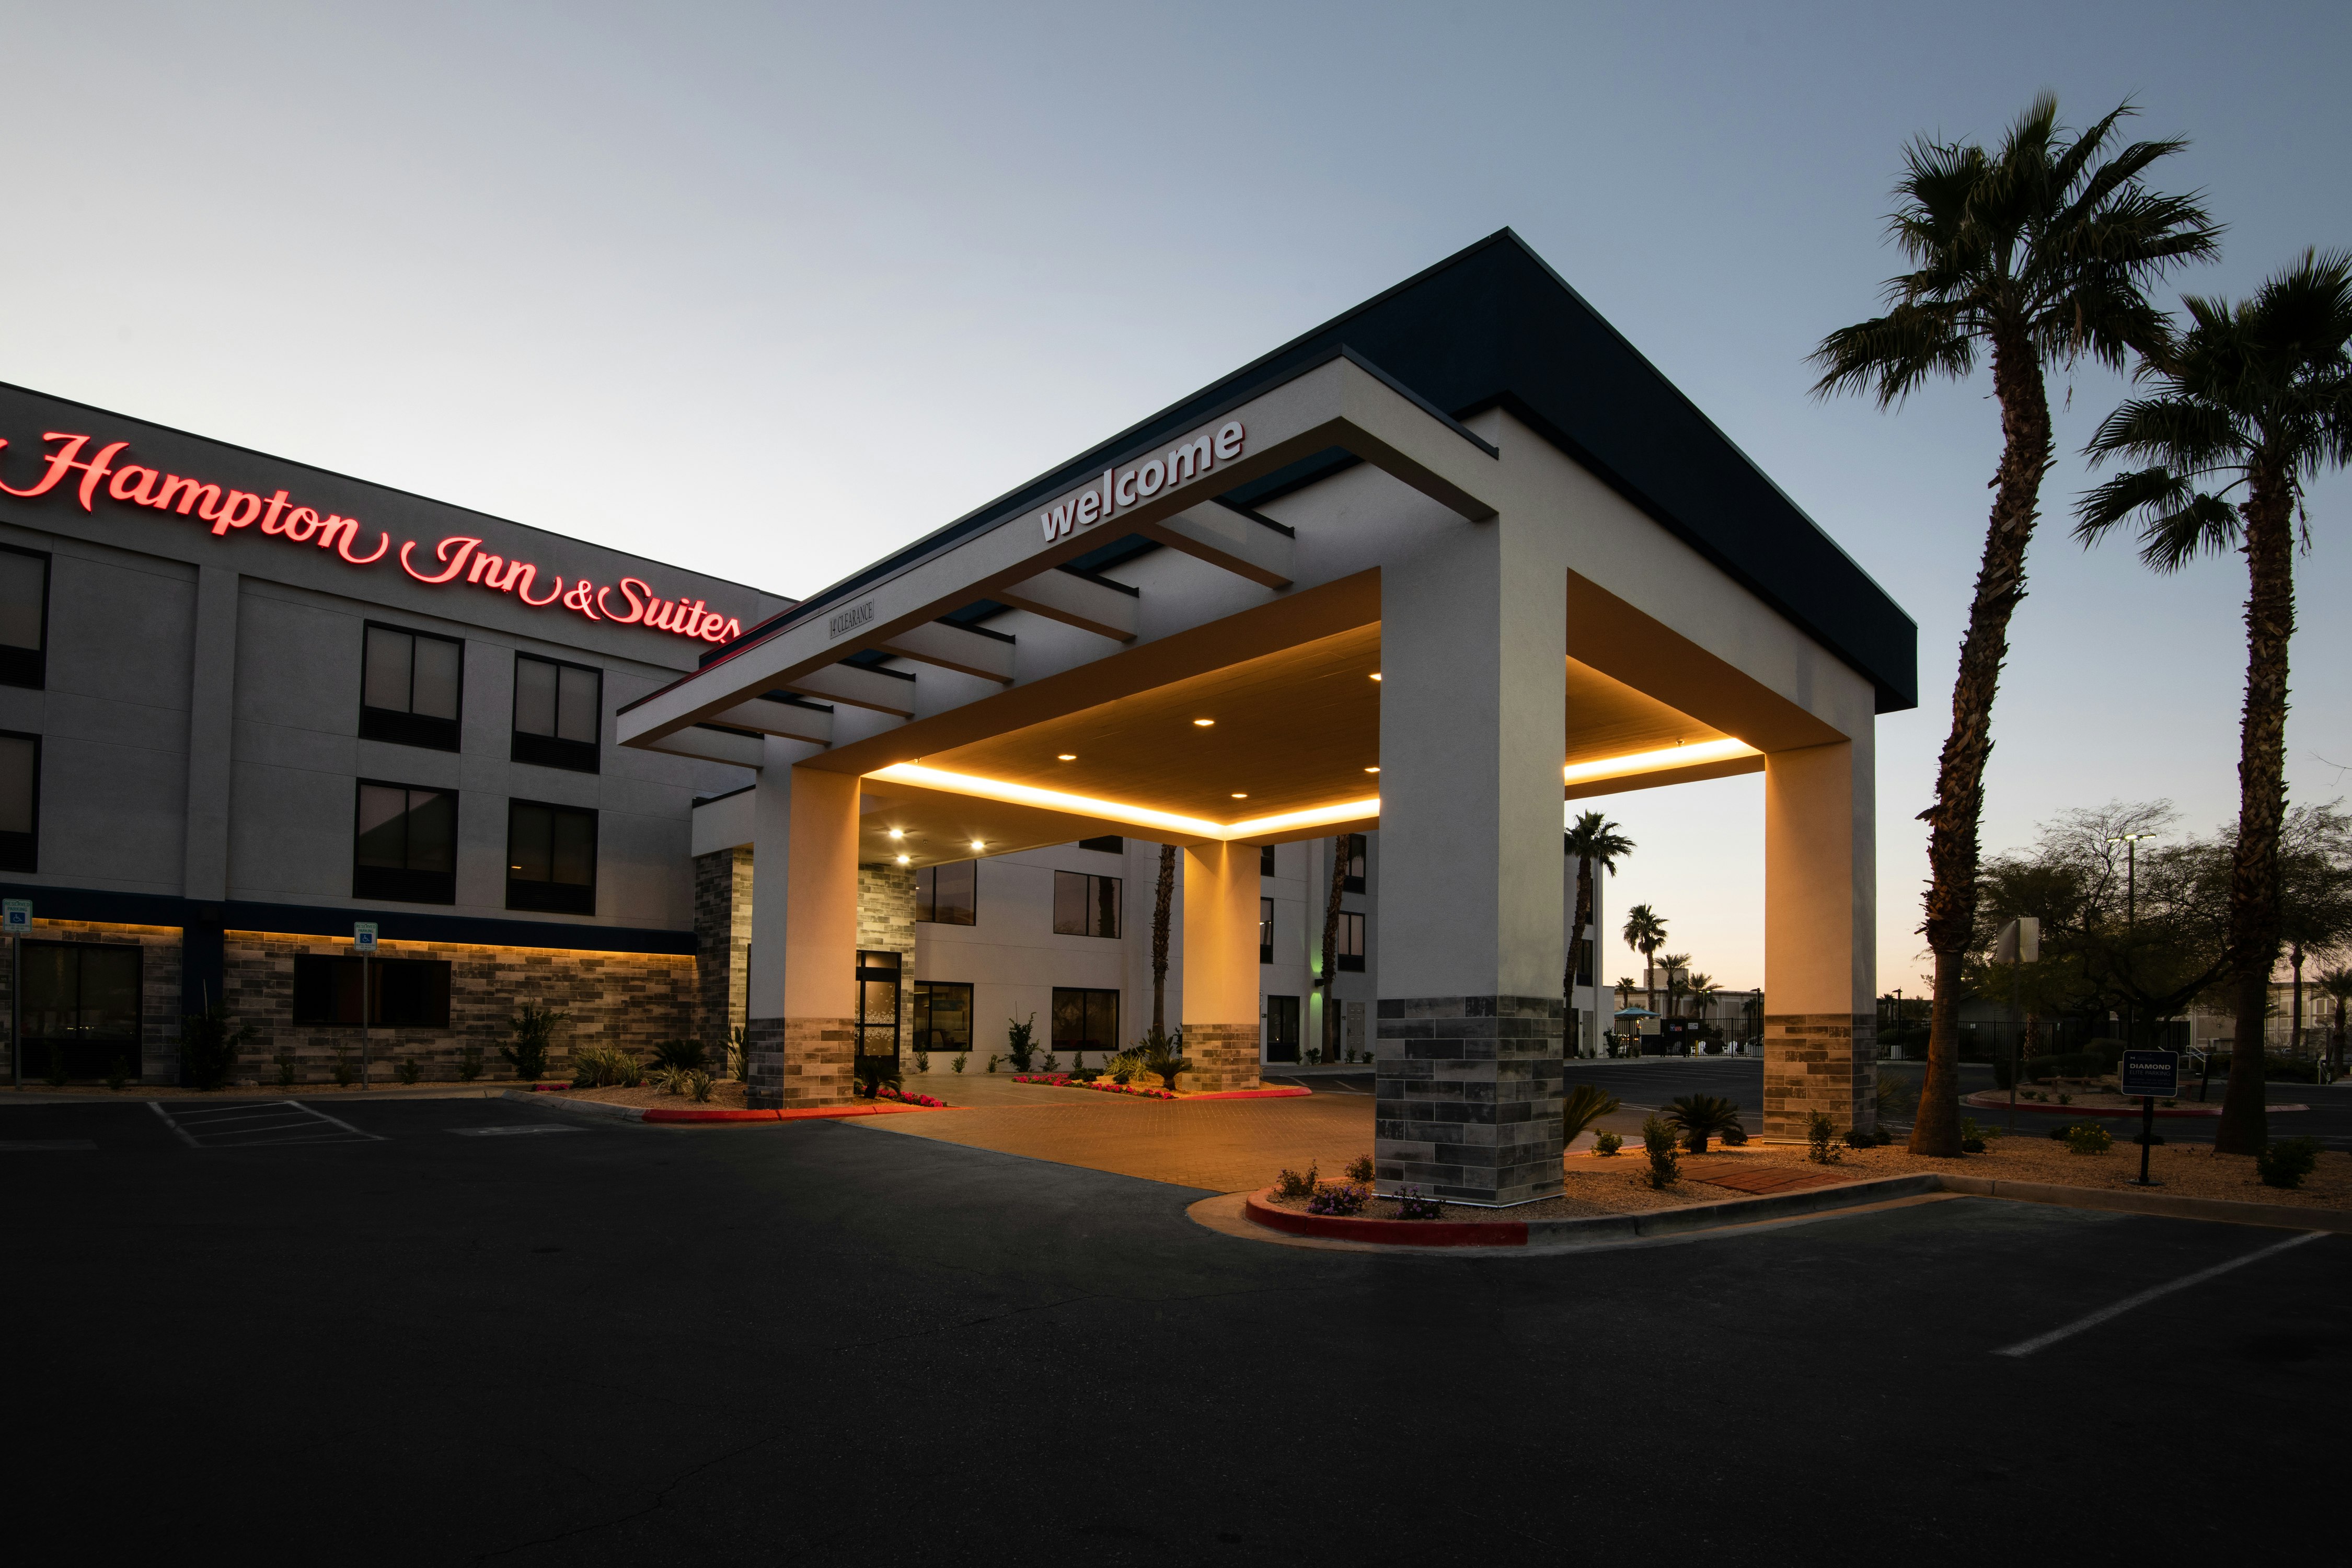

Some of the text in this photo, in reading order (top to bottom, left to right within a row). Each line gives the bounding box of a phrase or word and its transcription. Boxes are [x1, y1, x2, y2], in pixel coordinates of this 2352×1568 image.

[0, 432, 741, 644] Hampton Inn & Suites
[1040, 421, 1245, 543] welcome
[837, 602, 872, 633] CLEARANCE
